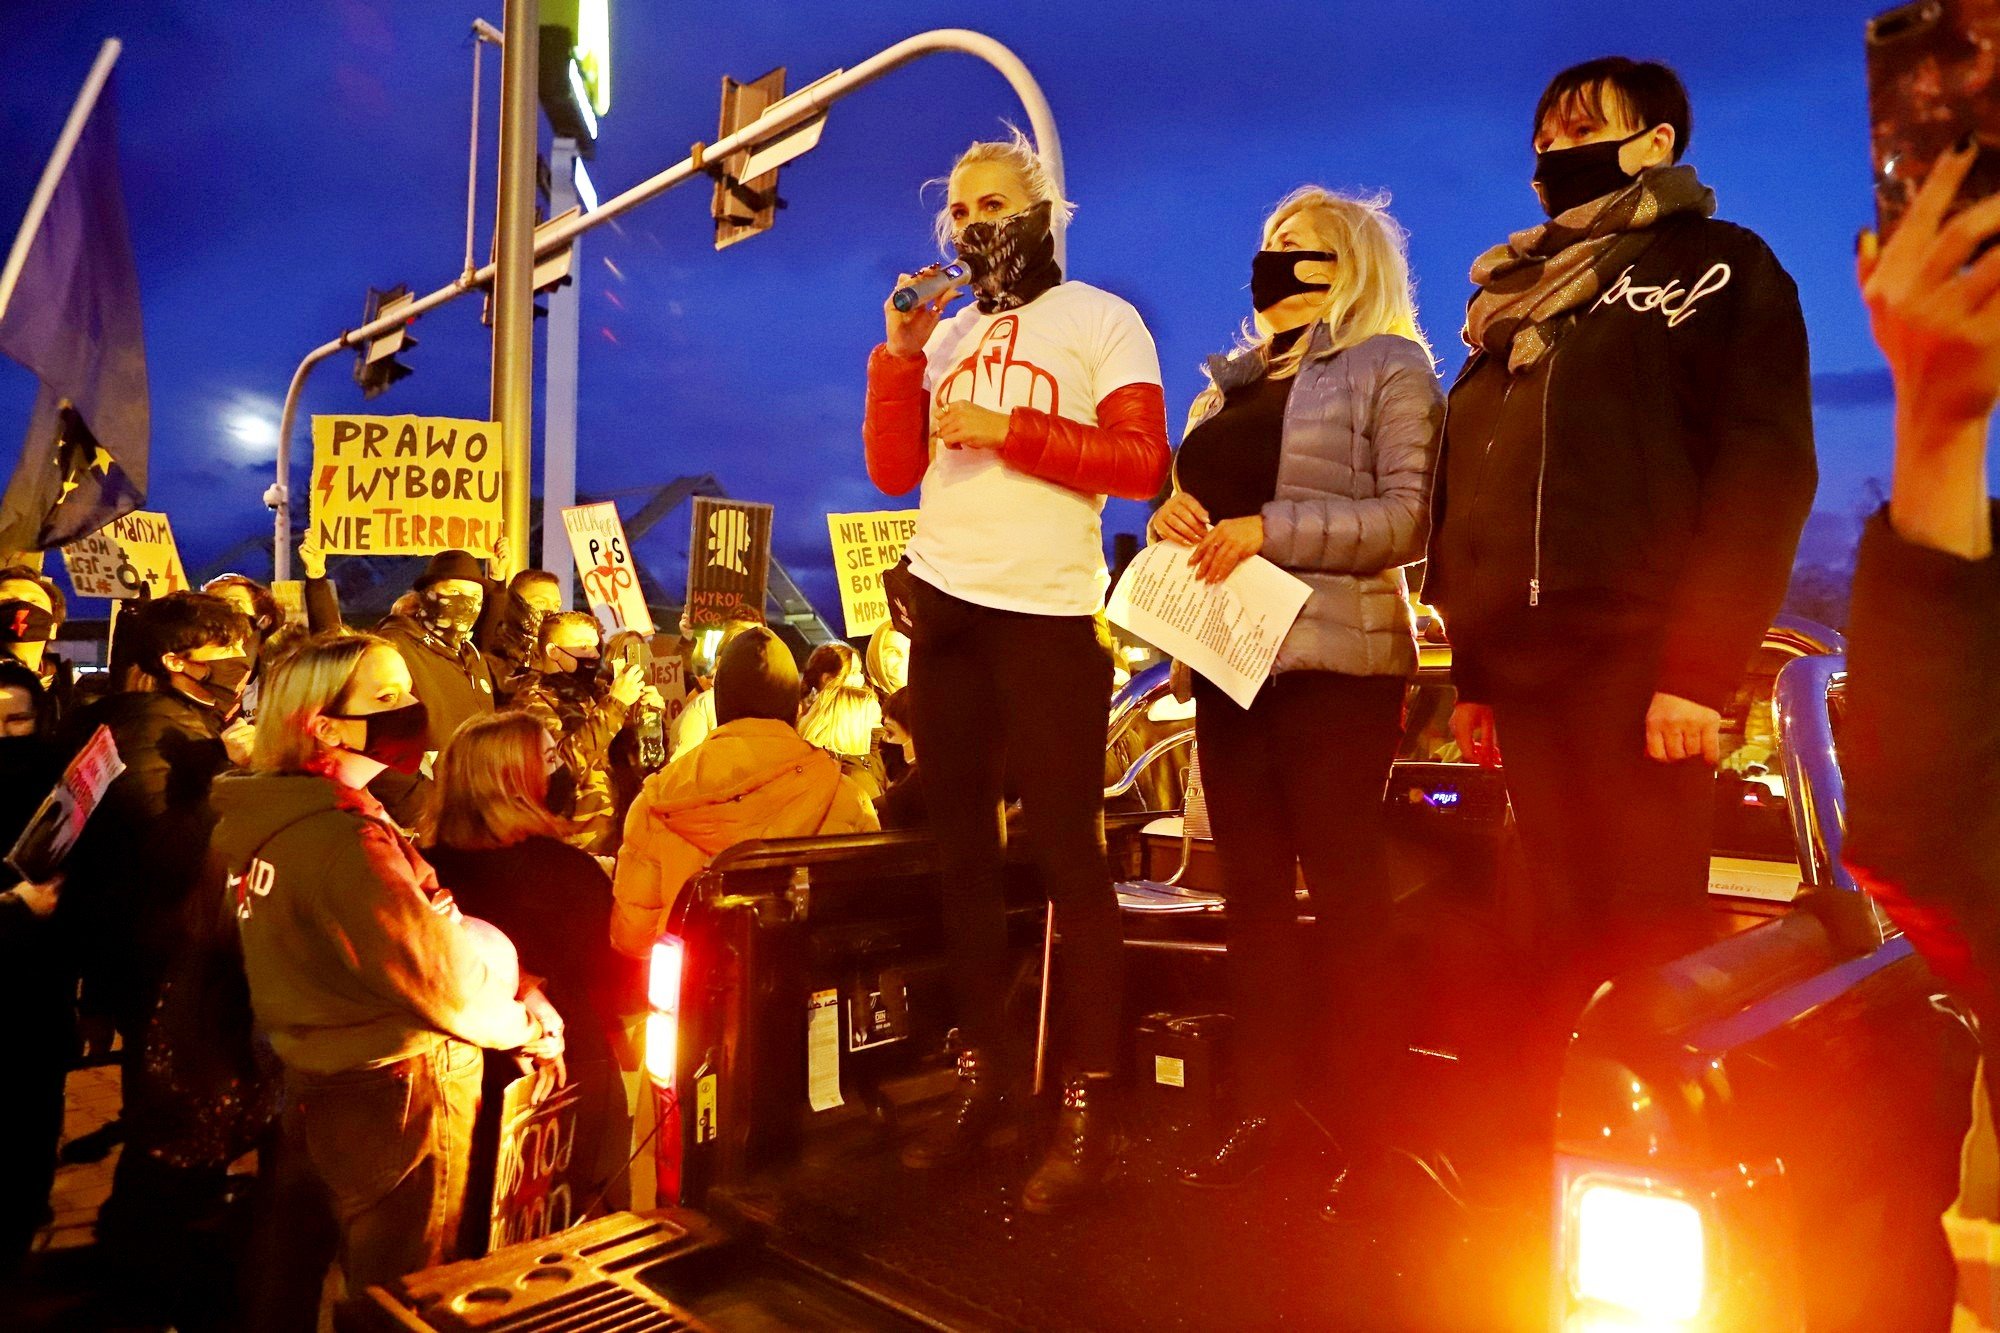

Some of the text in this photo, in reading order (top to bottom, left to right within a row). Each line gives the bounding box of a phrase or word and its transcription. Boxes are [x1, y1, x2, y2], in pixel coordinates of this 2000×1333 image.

[333, 420, 488, 463] PRAWO
[347, 464, 500, 503] WYBORU
[319, 507, 503, 554] NIE TERRORU
[840, 519, 917, 544] NIE INTER
[846, 546, 875, 570] SIE
[851, 575, 872, 594] BO
[693, 590, 744, 608] WYROK
